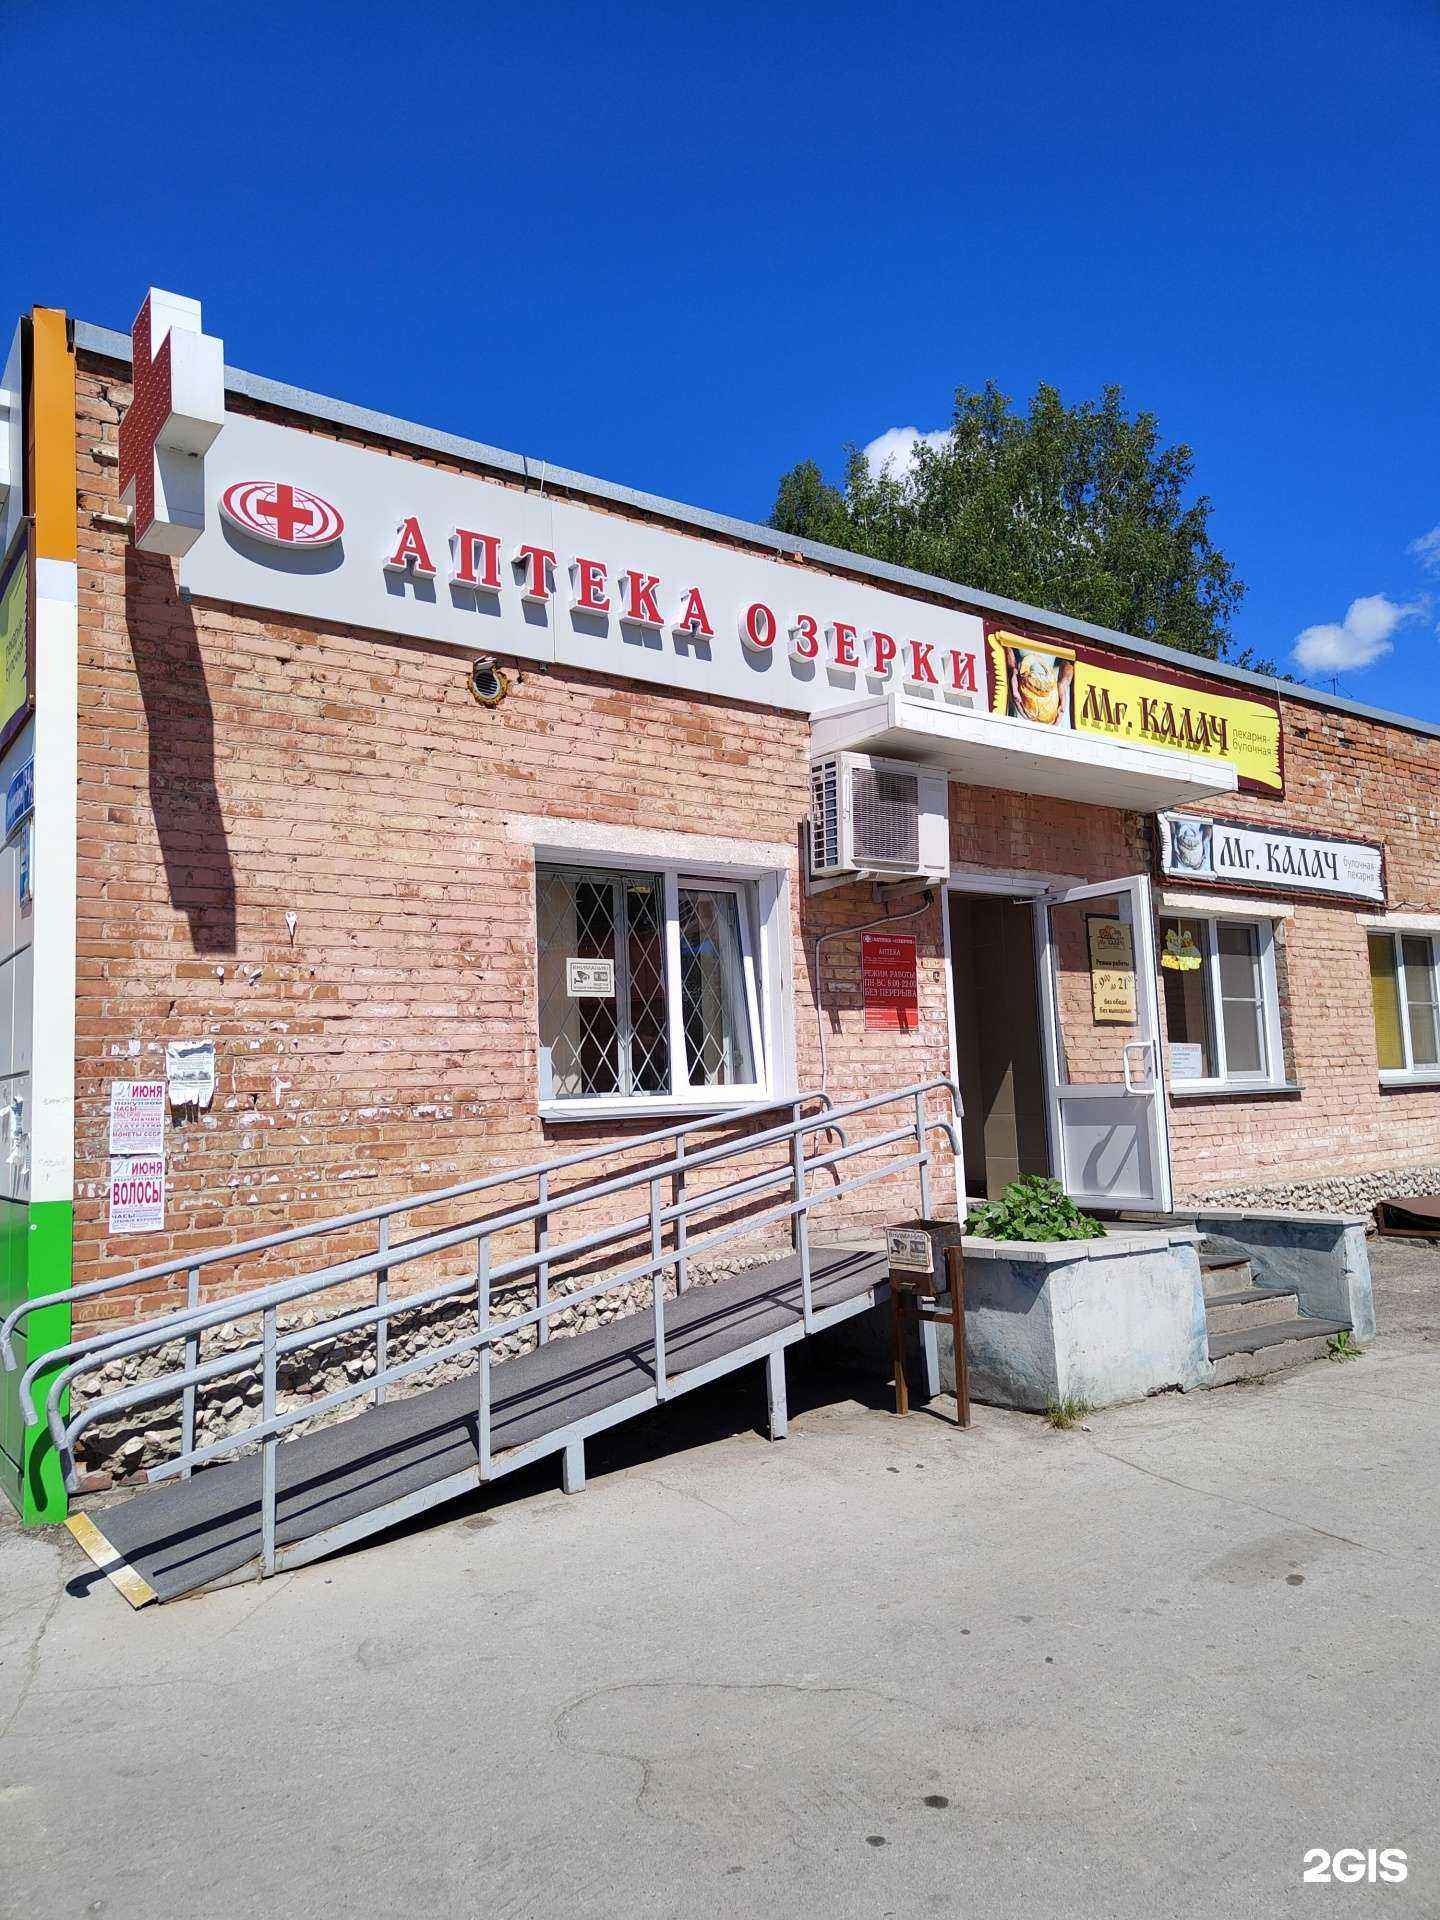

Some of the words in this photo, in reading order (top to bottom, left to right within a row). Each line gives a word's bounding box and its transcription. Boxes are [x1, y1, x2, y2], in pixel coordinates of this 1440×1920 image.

[388, 514, 716, 638] АПТЕКА
[744, 601, 979, 693] ОЗЕРКИ
[1138, 696, 1229, 751] КАЛАЧ
[1232, 728, 1270, 744] пекарня-
[1232, 737, 1272, 756] булочная
[1265, 842, 1339, 880] КАЛАЧ
[1347, 869, 1375, 882] пекарня
[879, 948, 901, 956] АПТЕКА
[131, 1084, 163, 1098] ИЮНЯ
[113, 1105, 137, 1113] ЧАСЫ
[131, 1161, 163, 1175] ИЮНЯ
[113, 1180, 162, 1206] ВОЛОСЫ
